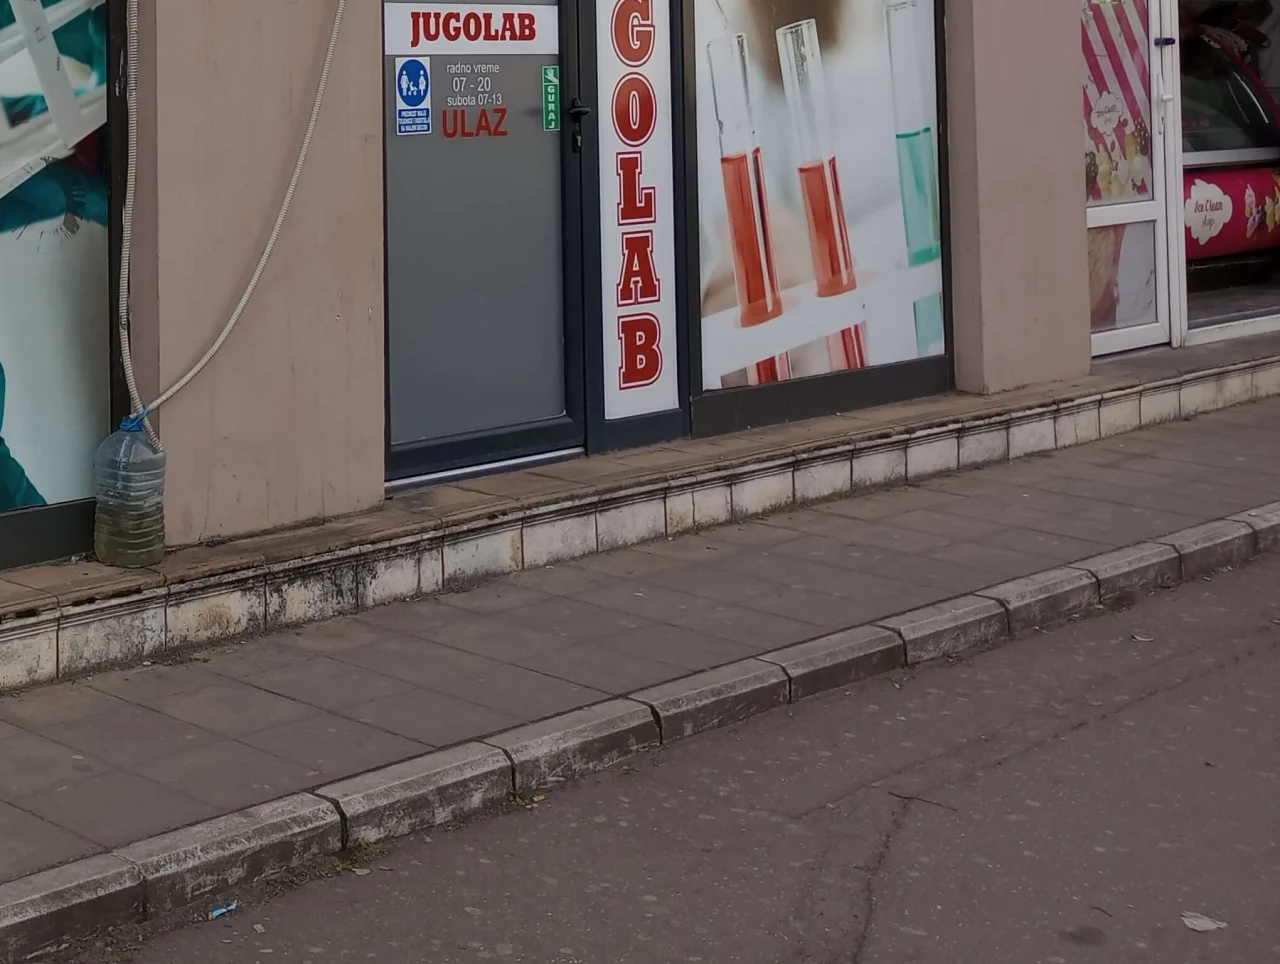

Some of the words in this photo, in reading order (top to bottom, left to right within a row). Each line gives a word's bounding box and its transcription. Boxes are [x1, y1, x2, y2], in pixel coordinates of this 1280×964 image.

[410, 11, 537, 48] JUGOLAB
[446, 62, 471, 74] radno
[473, 63, 500, 74] vreme
[452, 78, 467, 92] 07
[477, 77, 491, 92] 20
[447, 94, 476, 106] subota
[477, 93, 503, 106] 07-13
[547, 85, 556, 130] GURAJ
[442, 108, 508, 139] ULAZ
